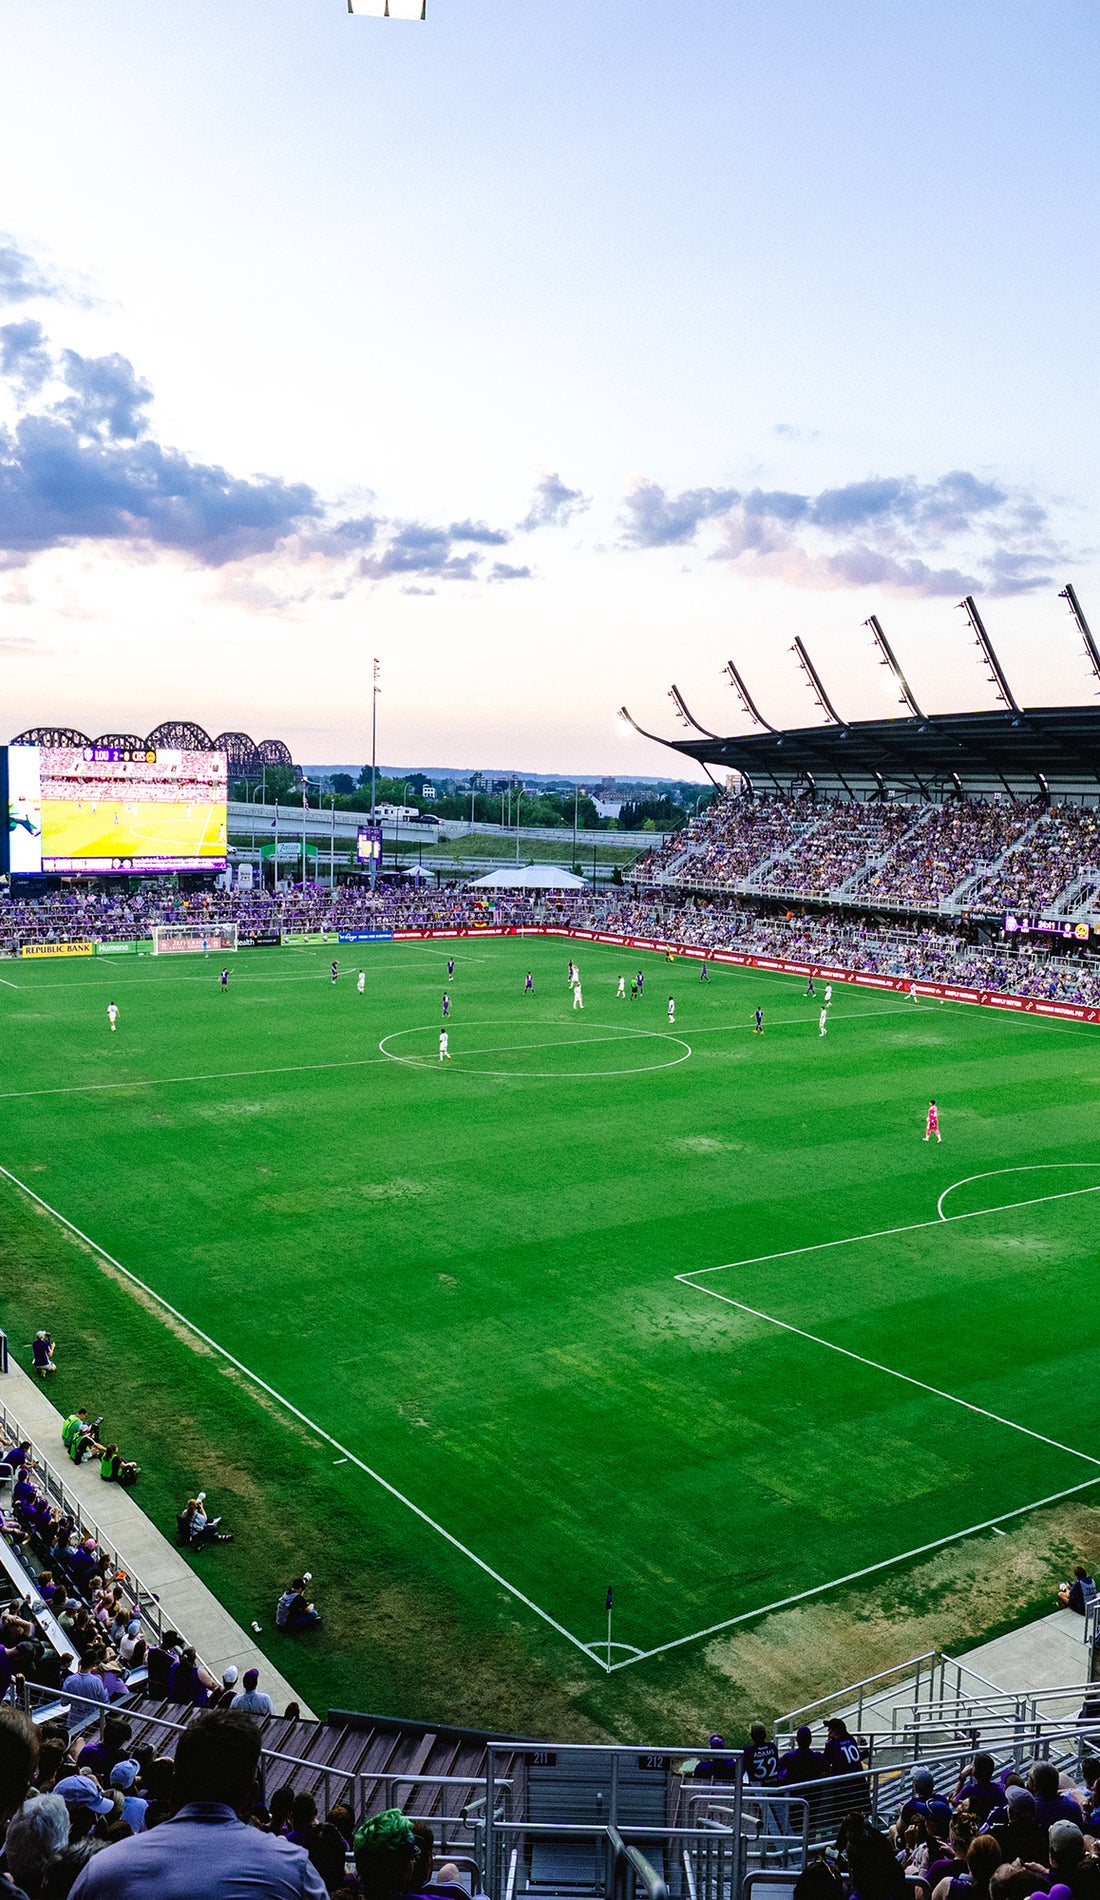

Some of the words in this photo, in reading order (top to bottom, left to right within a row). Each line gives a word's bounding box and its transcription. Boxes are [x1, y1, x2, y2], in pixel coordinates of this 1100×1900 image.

[95, 751, 109, 761] LOU
[25, 944, 65, 954] REPUBLIC
[67, 944, 90, 952] BANK
[99, 944, 129, 952] Humana
[753, 1748, 775, 1758] ADAMS
[841, 1745, 860, 1764] 10
[533, 1753, 548, 1764] 211
[647, 1756, 663, 1768] 212
[753, 1757, 779, 1779] 32
